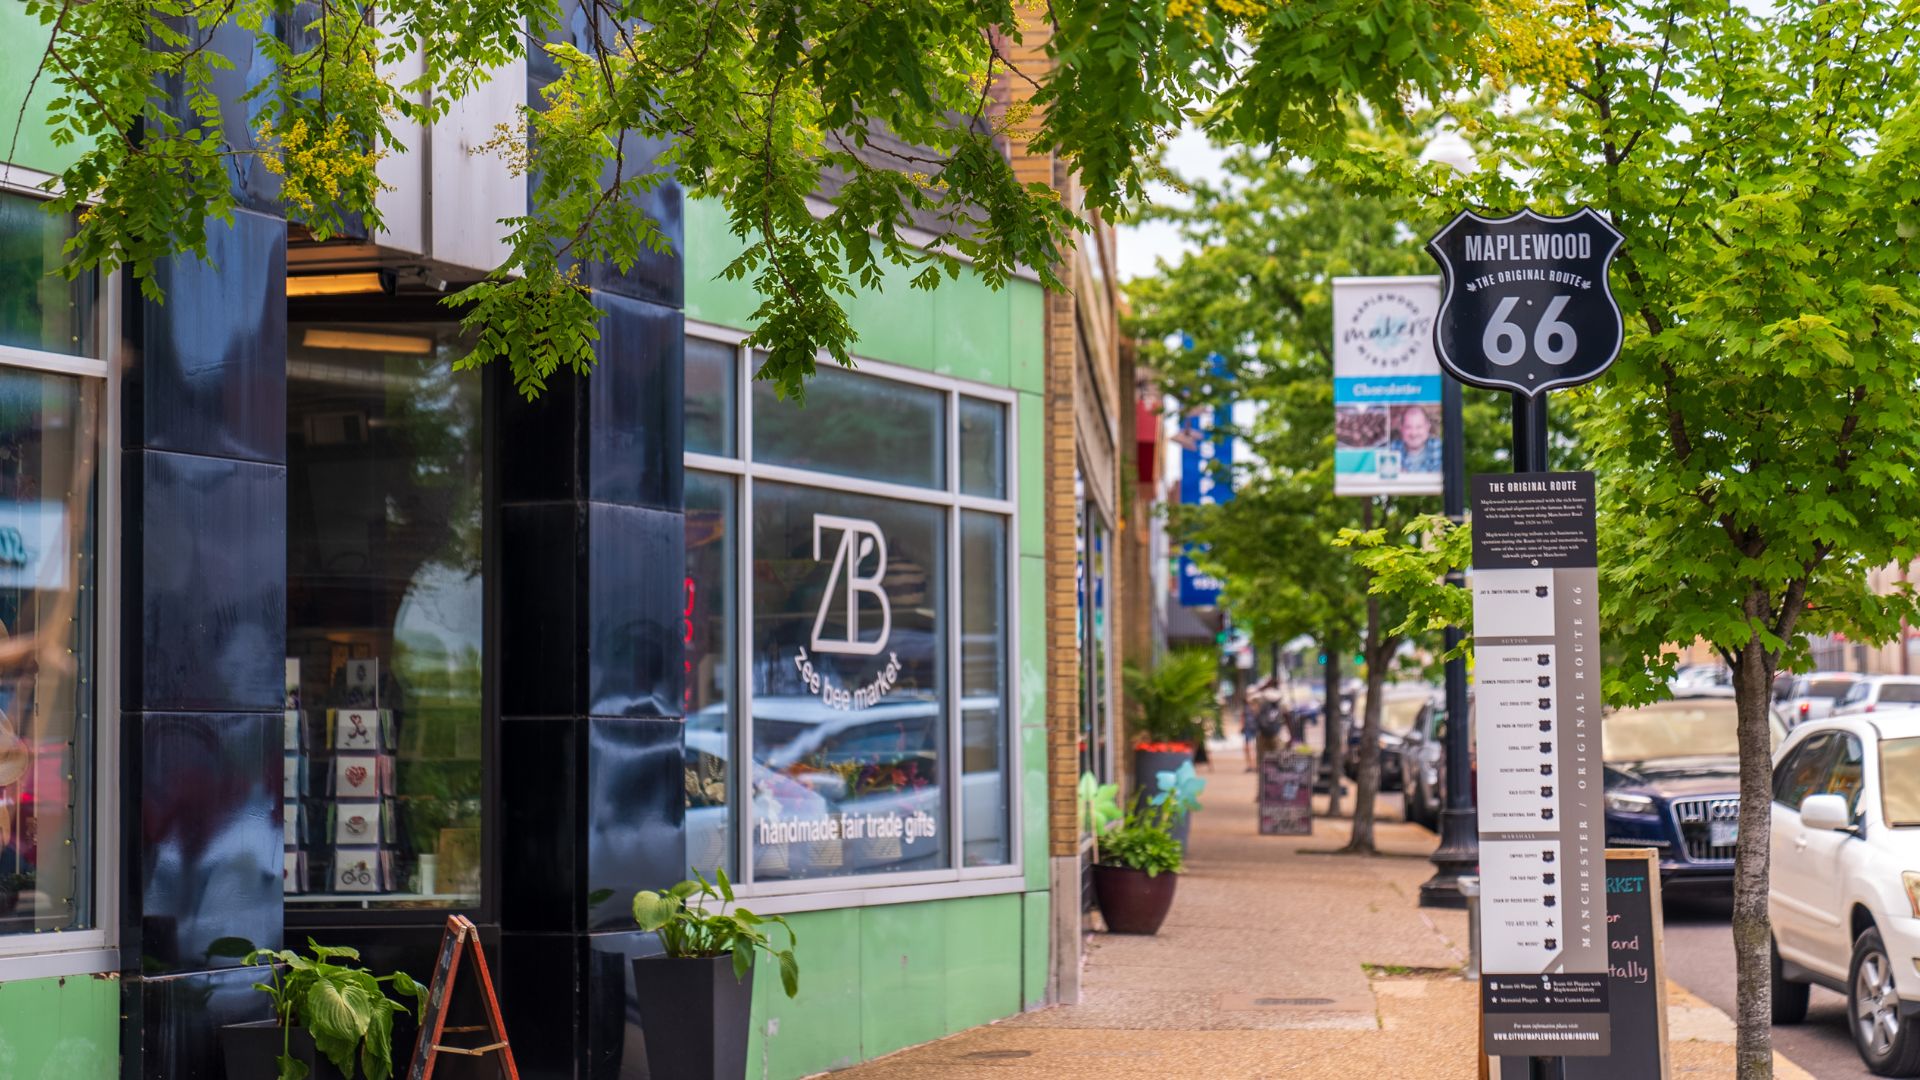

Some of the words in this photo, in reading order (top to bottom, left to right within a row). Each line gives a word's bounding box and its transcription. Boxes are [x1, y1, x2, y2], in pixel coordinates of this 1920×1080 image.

[1464, 233, 1591, 262] MAPLEWOOD
[1474, 275, 1496, 289] THE
[1498, 269, 1546, 283] ORIGINAL
[1549, 270, 1582, 288] ROUTE
[1482, 295, 1578, 366] 66
[1489, 482, 1504, 493] THE
[1508, 481, 1547, 492] ORIGINAL
[1550, 480, 1577, 491] ROUTE
[1573, 587, 1582, 605] 66
[1574, 618, 1584, 680] ROUTE
[794, 646, 820, 694] zee
[822, 676, 850, 711] bee
[854, 651, 902, 711] market
[1576, 692, 1587, 790] ORIGINAL
[760, 814, 839, 844] handmade
[841, 812, 864, 839] fair
[866, 810, 902, 838] trade
[904, 810, 936, 844] gifts
[1579, 821, 1591, 948] MANCHESTER
[1612, 936, 1639, 951] and
